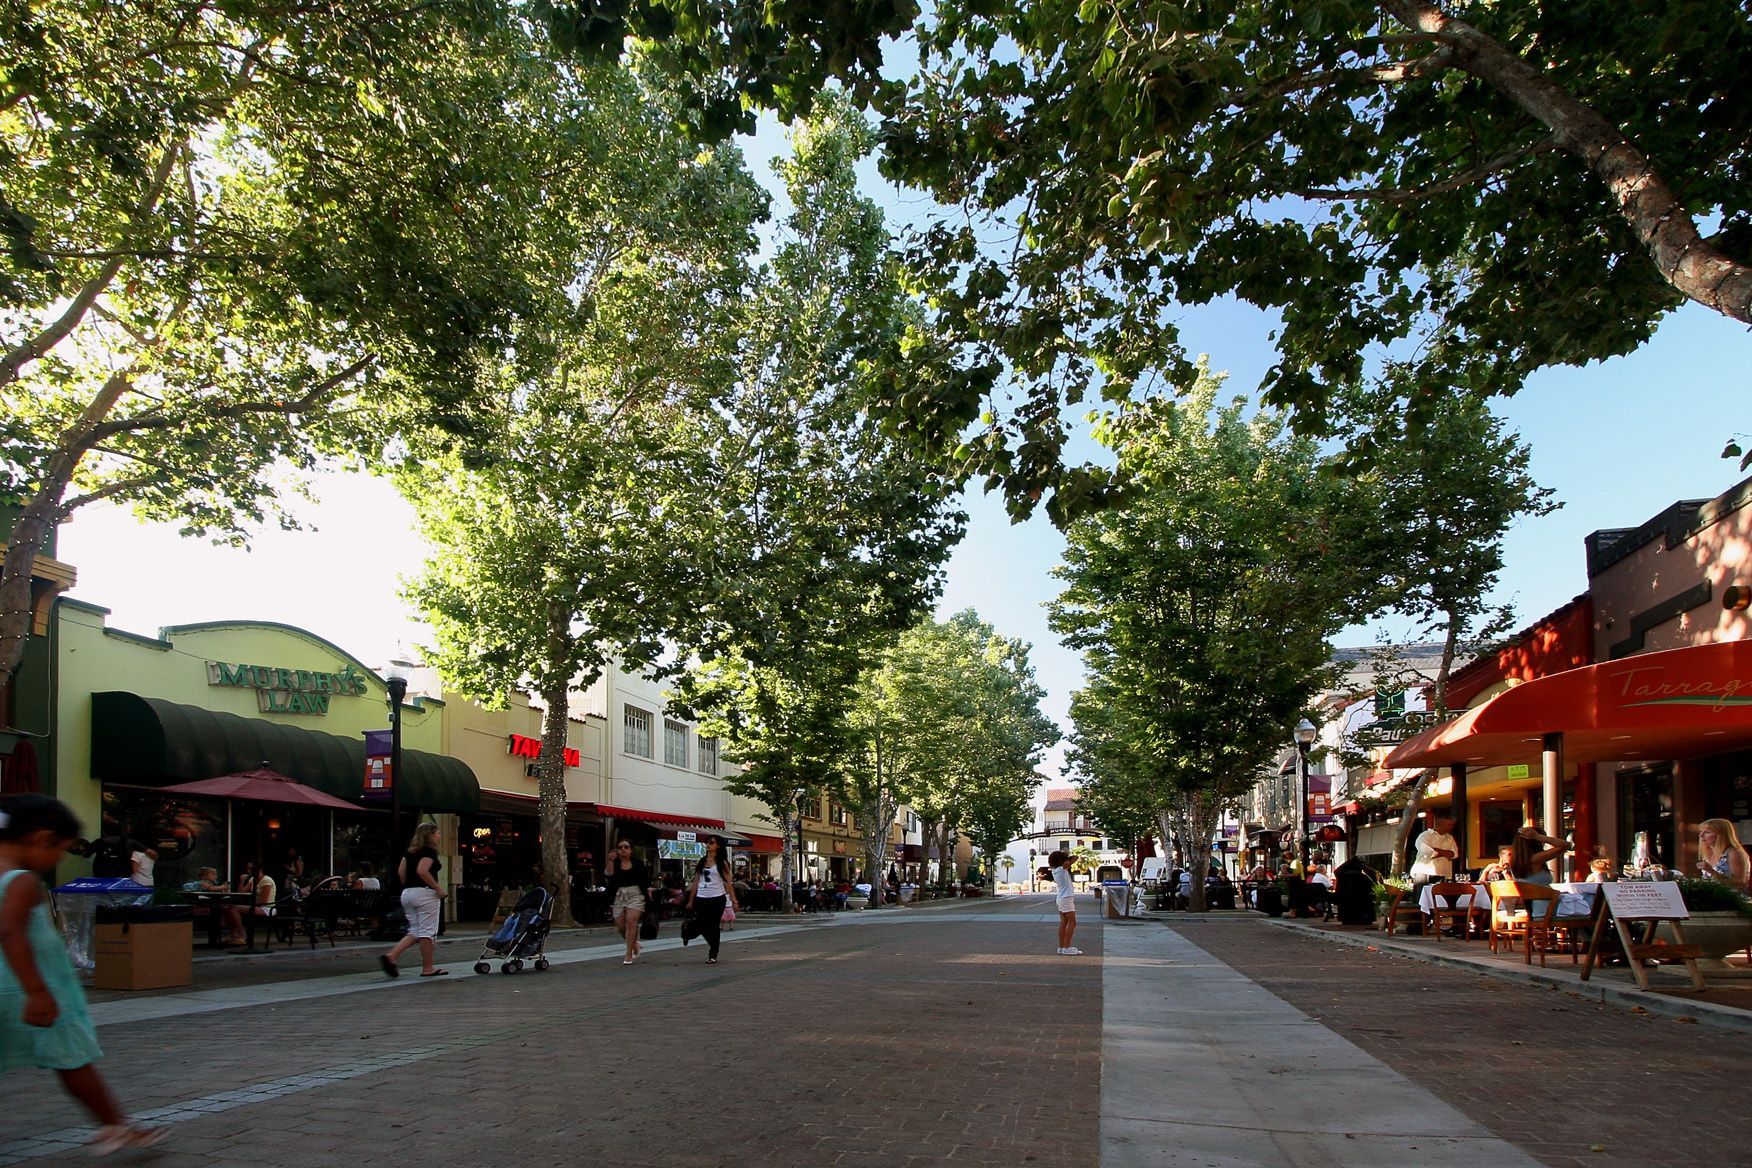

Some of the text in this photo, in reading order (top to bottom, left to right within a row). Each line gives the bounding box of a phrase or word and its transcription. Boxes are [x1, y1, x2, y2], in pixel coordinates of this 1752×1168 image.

[217, 661, 369, 695] MURPHY'S
[1609, 666, 1752, 713] Tarrag
[267, 690, 331, 714] LAW
[513, 734, 580, 767] TAVNA
